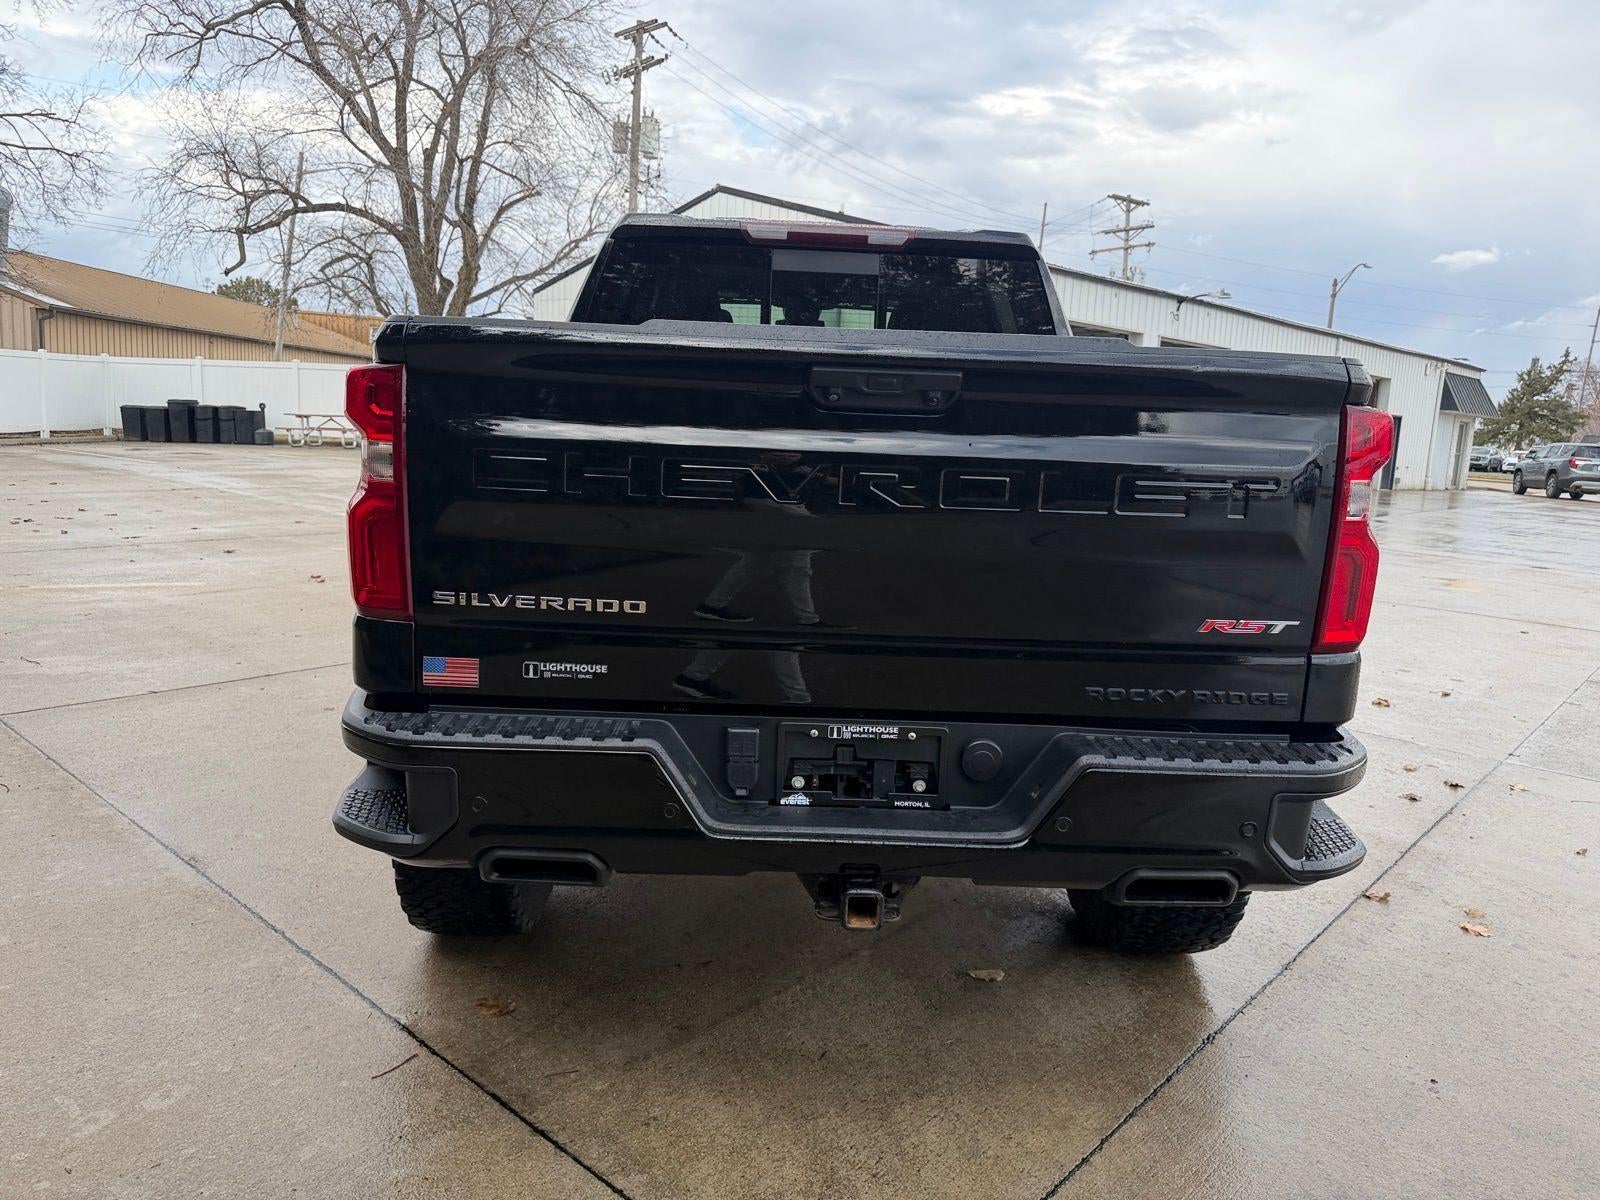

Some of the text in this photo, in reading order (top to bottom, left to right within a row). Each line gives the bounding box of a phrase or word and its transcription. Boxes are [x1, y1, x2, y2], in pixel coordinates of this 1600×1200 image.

[472, 447, 1281, 520] CHEVROLET
[432, 590, 647, 614] SILVERADO
[1196, 618, 1300, 634] RST
[540, 662, 608, 674] LIGHTHOUSE
[1085, 686, 1289, 706] ROCKY RIDGE
[842, 725, 899, 734] LIGHTHOUSE
